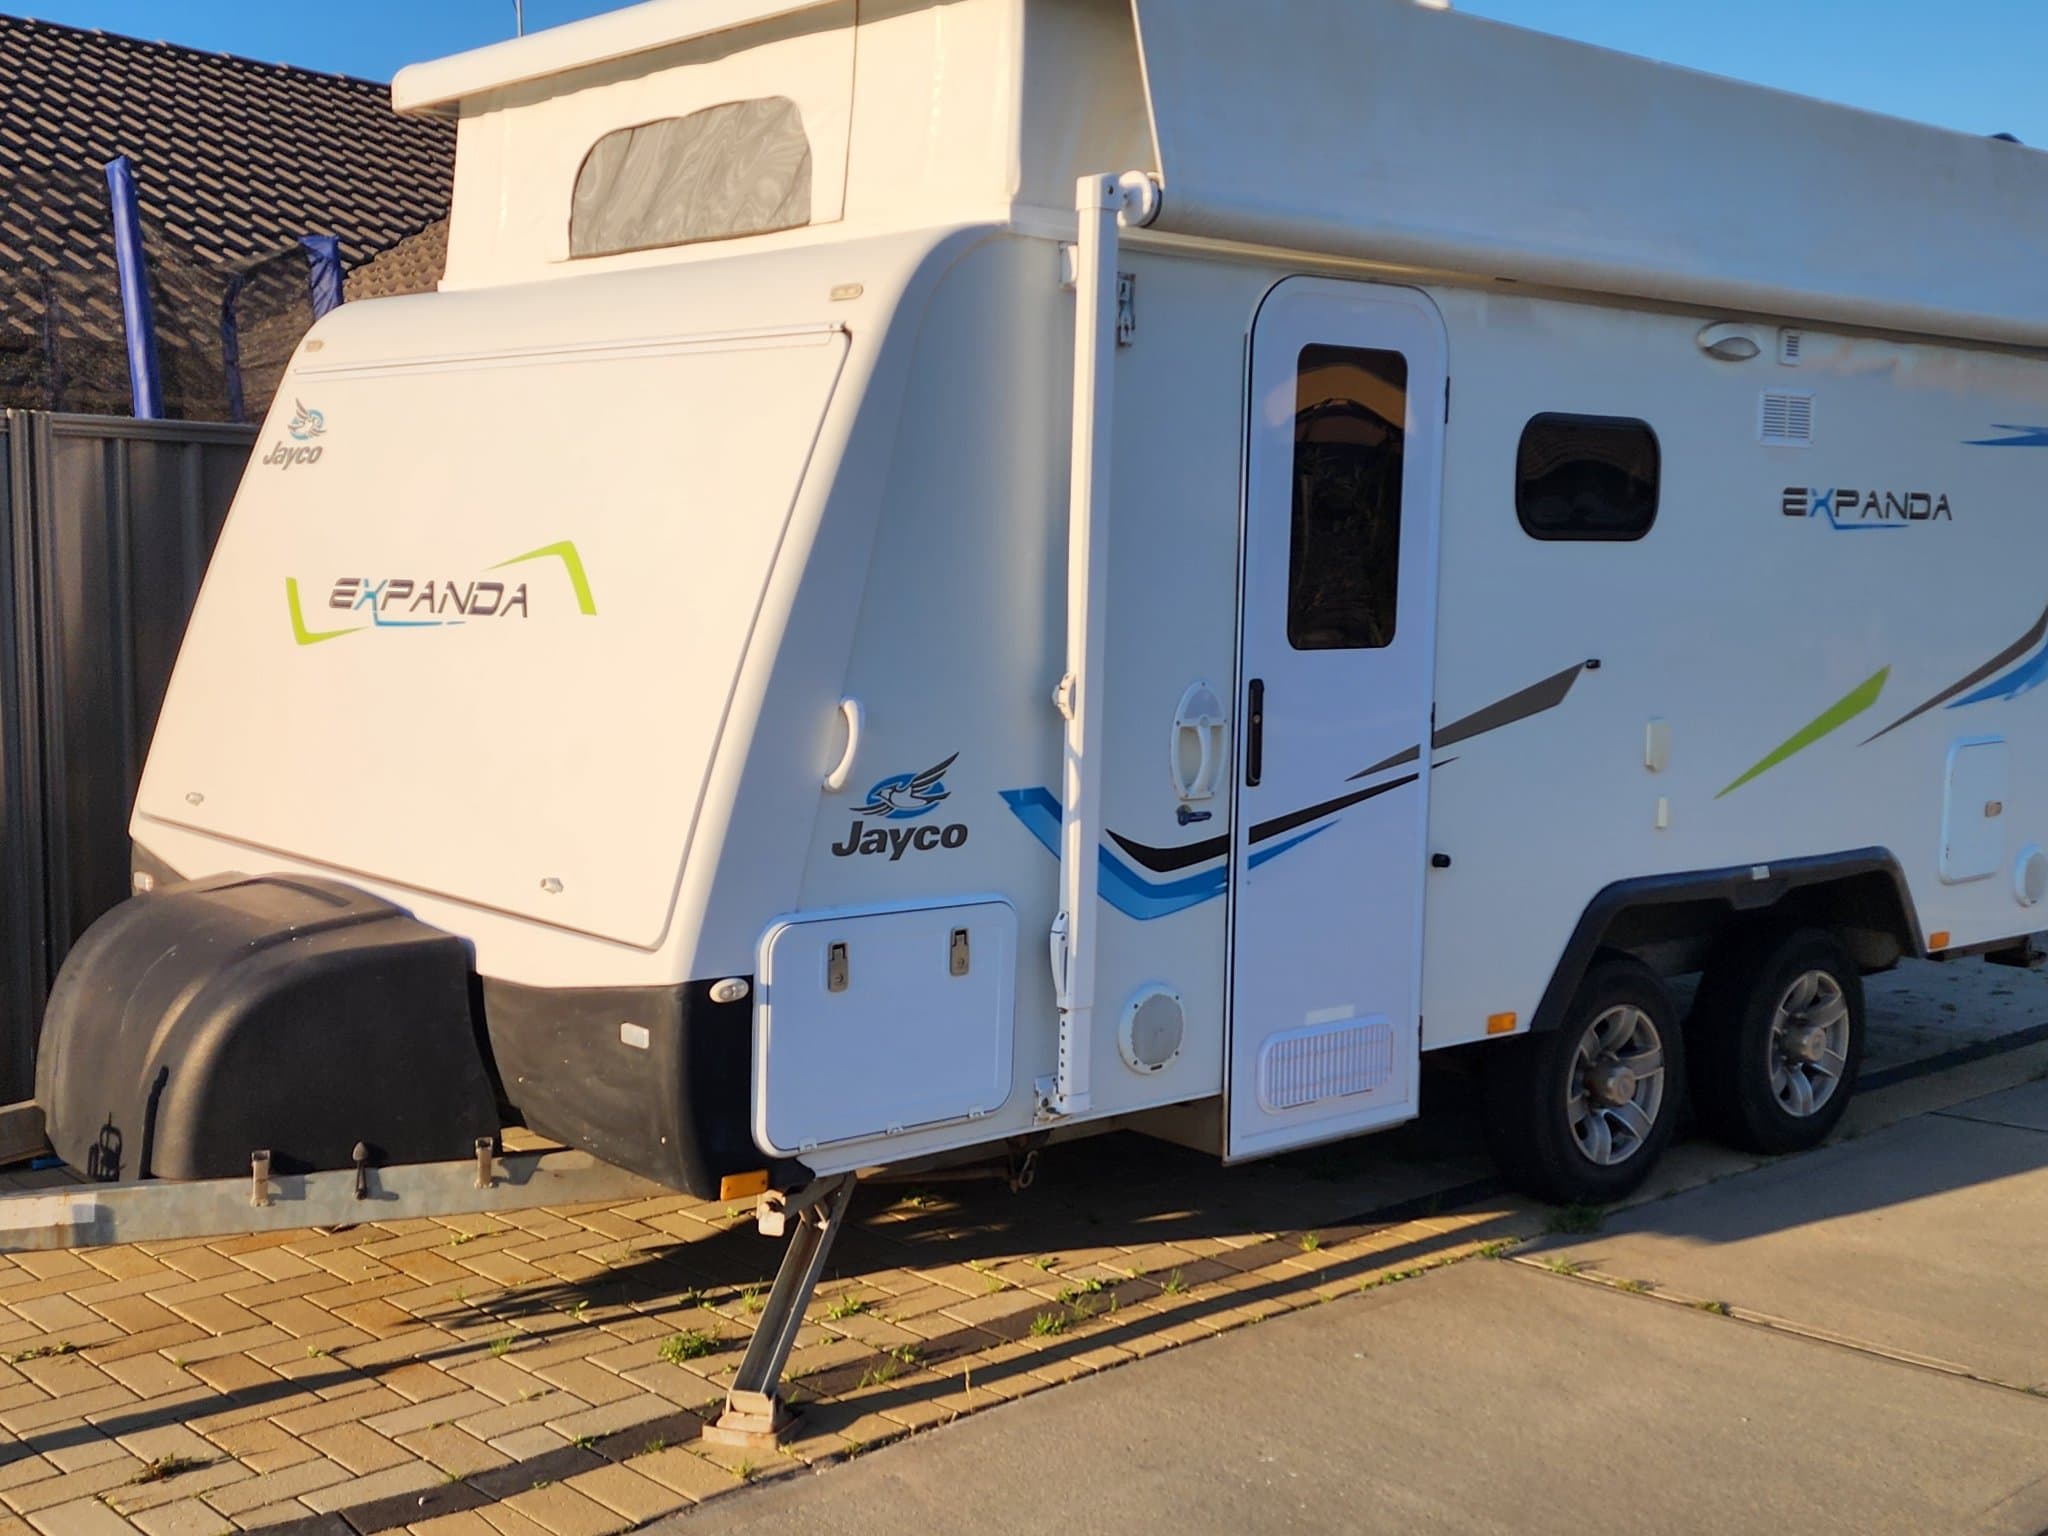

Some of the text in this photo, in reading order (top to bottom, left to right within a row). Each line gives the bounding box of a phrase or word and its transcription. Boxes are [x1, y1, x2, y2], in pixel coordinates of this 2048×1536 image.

[263, 440, 323, 471] Jayco
[1783, 487, 1952, 521] EXPANDA
[329, 577, 528, 619] EXPANDA
[831, 820, 968, 861] Jayco
